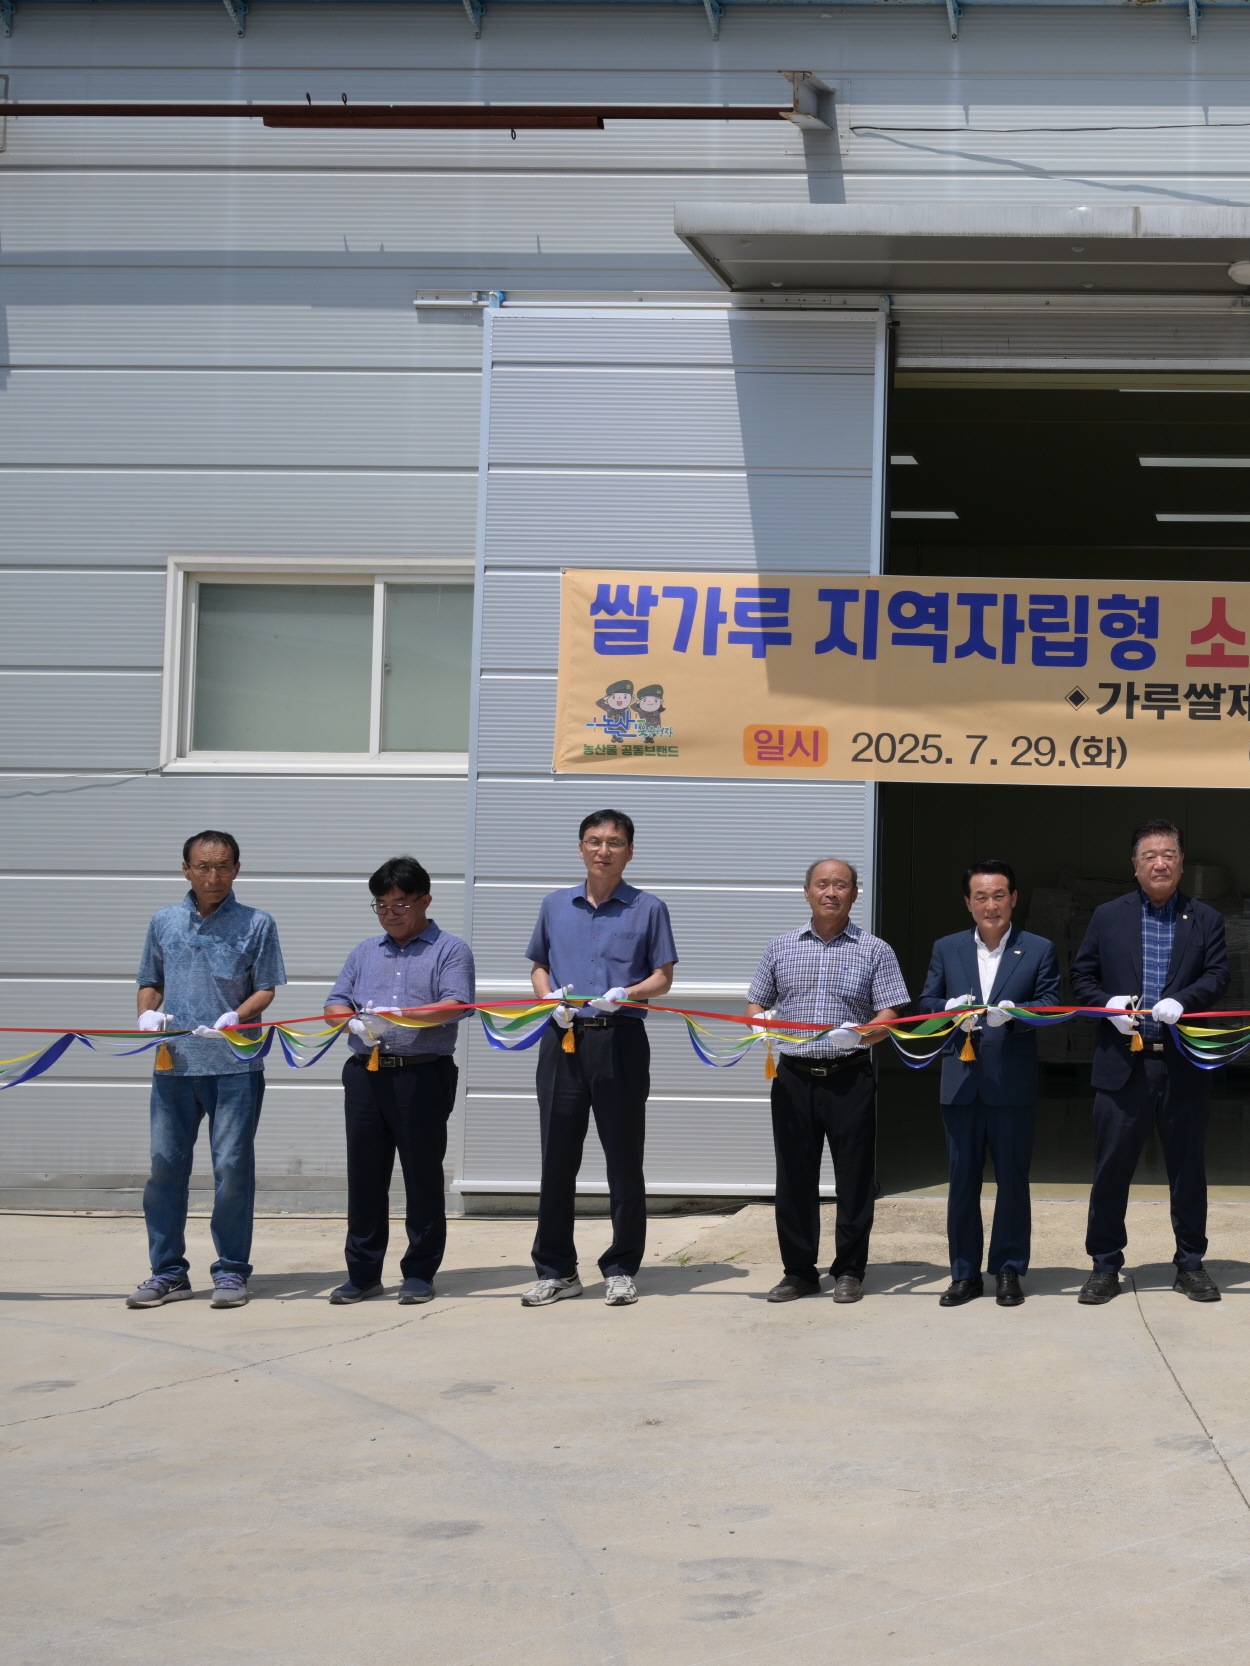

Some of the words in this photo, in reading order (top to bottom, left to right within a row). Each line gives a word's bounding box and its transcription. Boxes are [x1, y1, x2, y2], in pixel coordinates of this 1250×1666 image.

[590, 583, 792, 658] 쌀가루
[815, 589, 1159, 671] 지역자립형
[583, 744, 618, 756] 농산물
[621, 744, 679, 757] 공동브랜드
[753, 730, 820, 762] 일시
